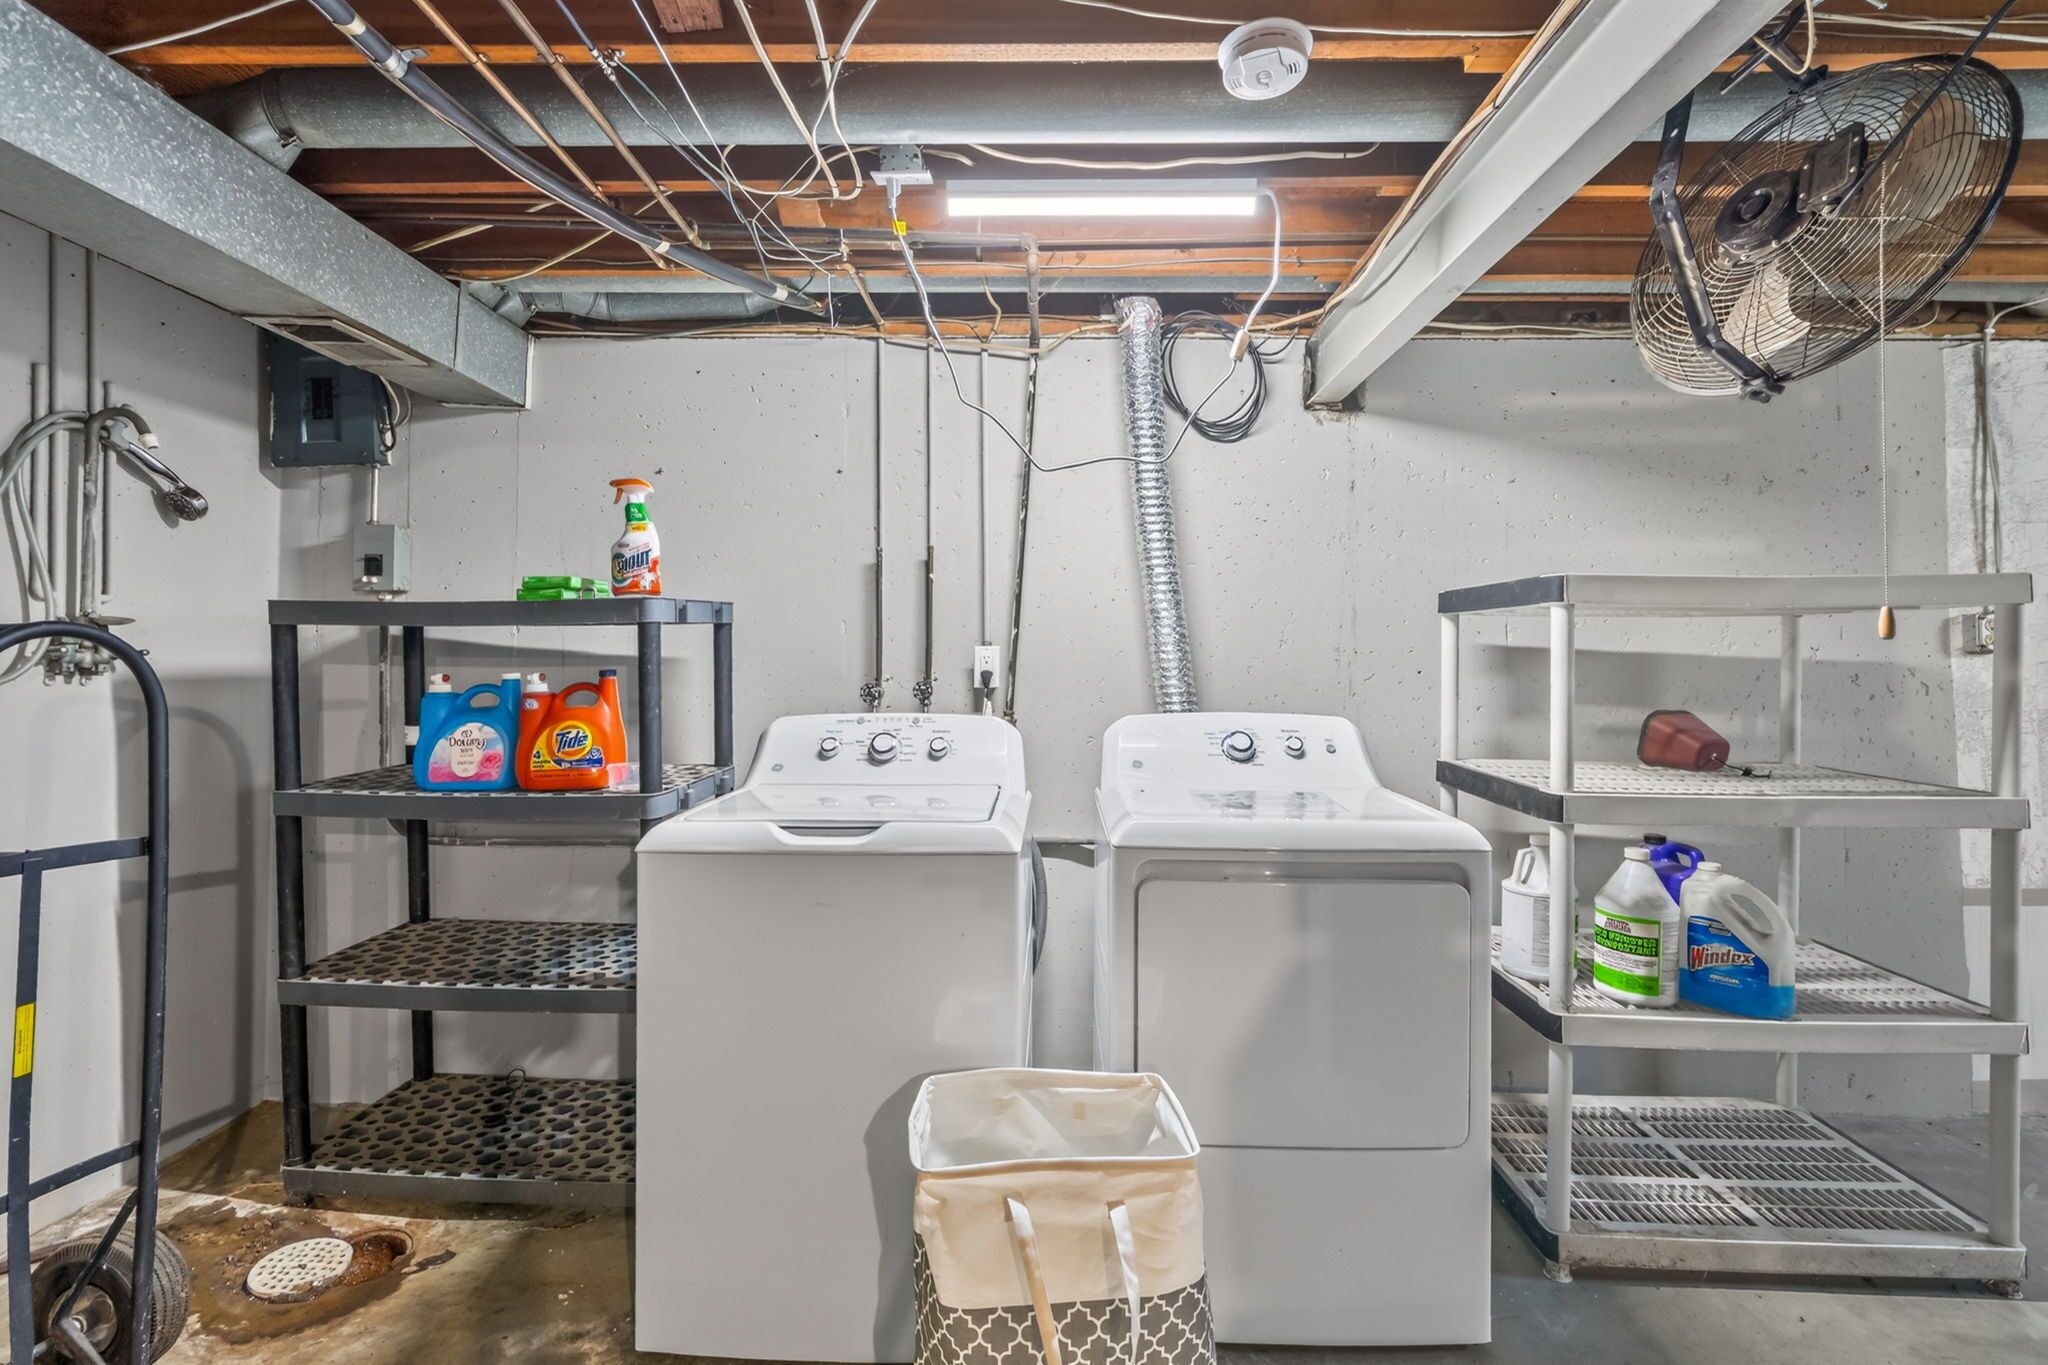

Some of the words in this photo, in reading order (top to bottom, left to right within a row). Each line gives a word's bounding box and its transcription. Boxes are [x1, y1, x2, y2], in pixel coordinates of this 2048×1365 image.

[449, 736, 485, 750] Downy
[556, 730, 588, 754] Tide
[1690, 944, 1755, 971] Windex
